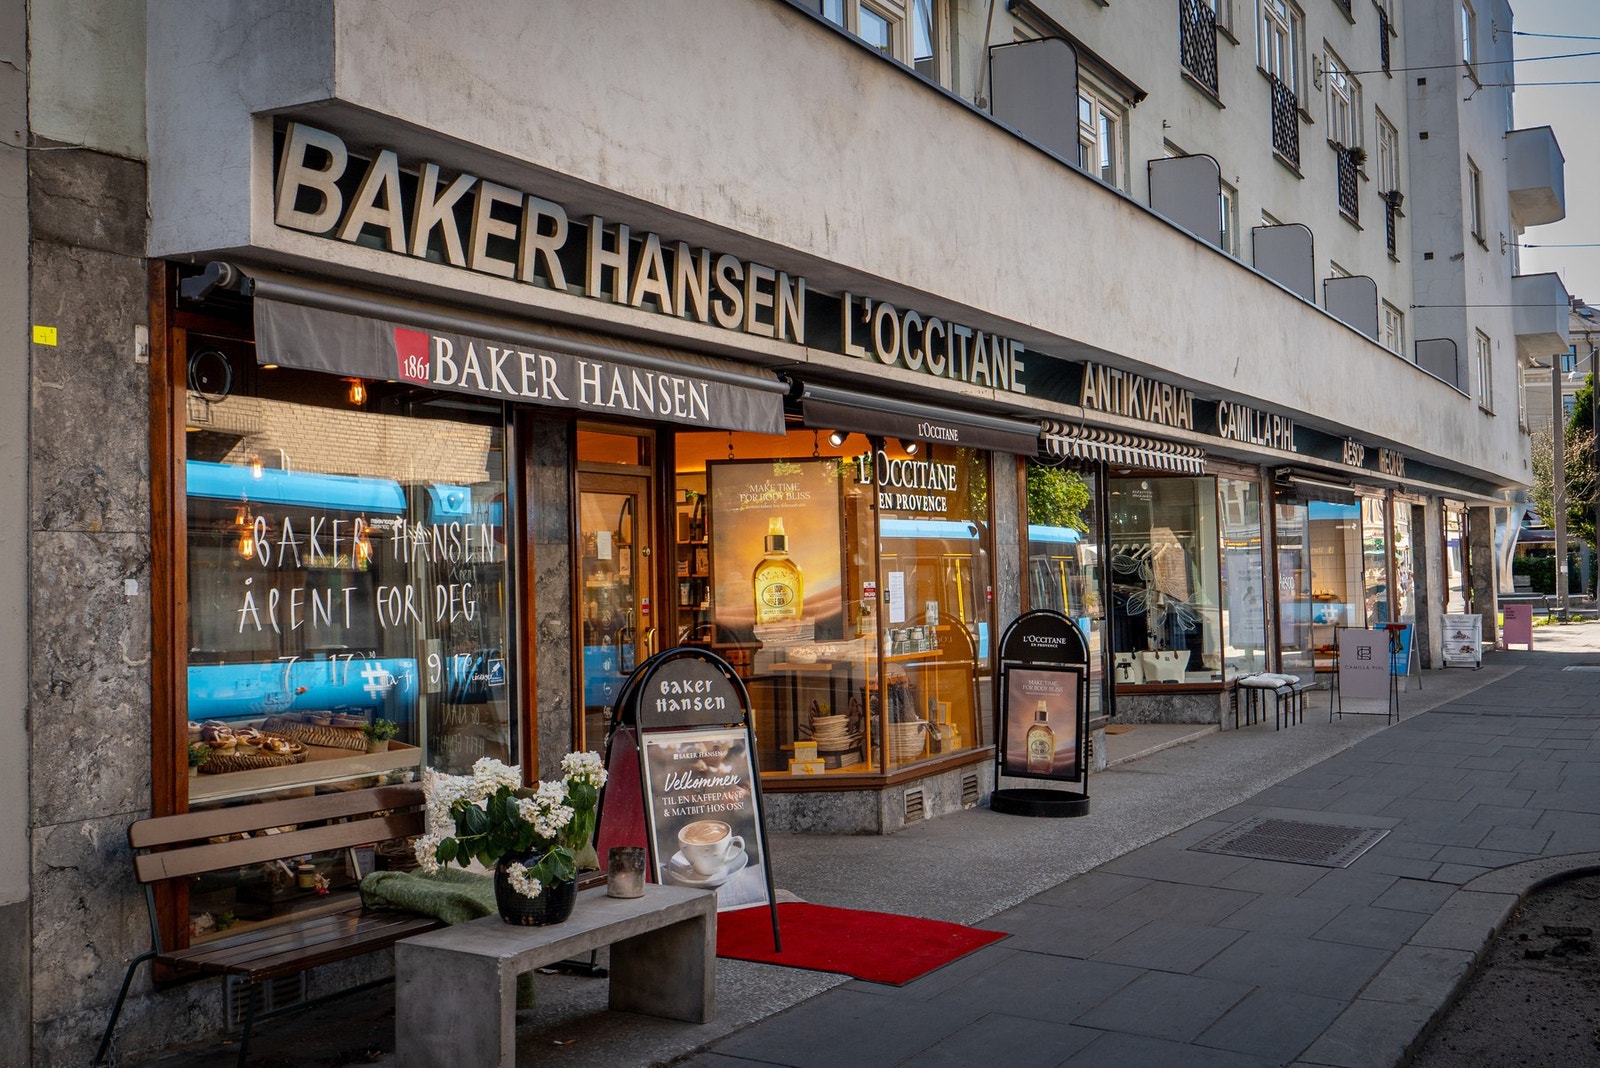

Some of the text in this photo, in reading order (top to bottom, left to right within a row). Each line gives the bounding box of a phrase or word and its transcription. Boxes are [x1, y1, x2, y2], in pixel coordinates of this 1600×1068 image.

[275, 122, 805, 344] BAKER HANSEN
[841, 292, 1026, 394] L'OCCITANE
[403, 336, 710, 421] 1861 BAKER HANSEN
[1080, 361, 1195, 430] ANTIKVARIAT
[918, 422, 959, 441] L'OCCITANE
[1217, 400, 1297, 452] CAMILLA PIHL
[859, 450, 957, 491] L'OCCITANE
[739, 491, 811, 502] FOR BODY BLISS
[749, 482, 800, 492] MAKE TIME
[879, 492, 947, 512] EN PROVENCE
[253, 515, 494, 569] BAKER HANSEN
[237, 578, 358, 634] ÅPENT
[376, 585, 422, 629] FOR
[436, 582, 476, 623] DEG
[1023, 635, 1067, 644] L'OCCITANE
[660, 679, 713, 695] Baker
[656, 696, 726, 713] Hansen
[678, 751, 723, 760] BAKER HANSEN
[664, 770, 741, 792] Velkommen
[662, 790, 745, 805] TIL EN KAFFEPAUSE
[663, 802, 744, 817] & MATBIT HOS OSS!
